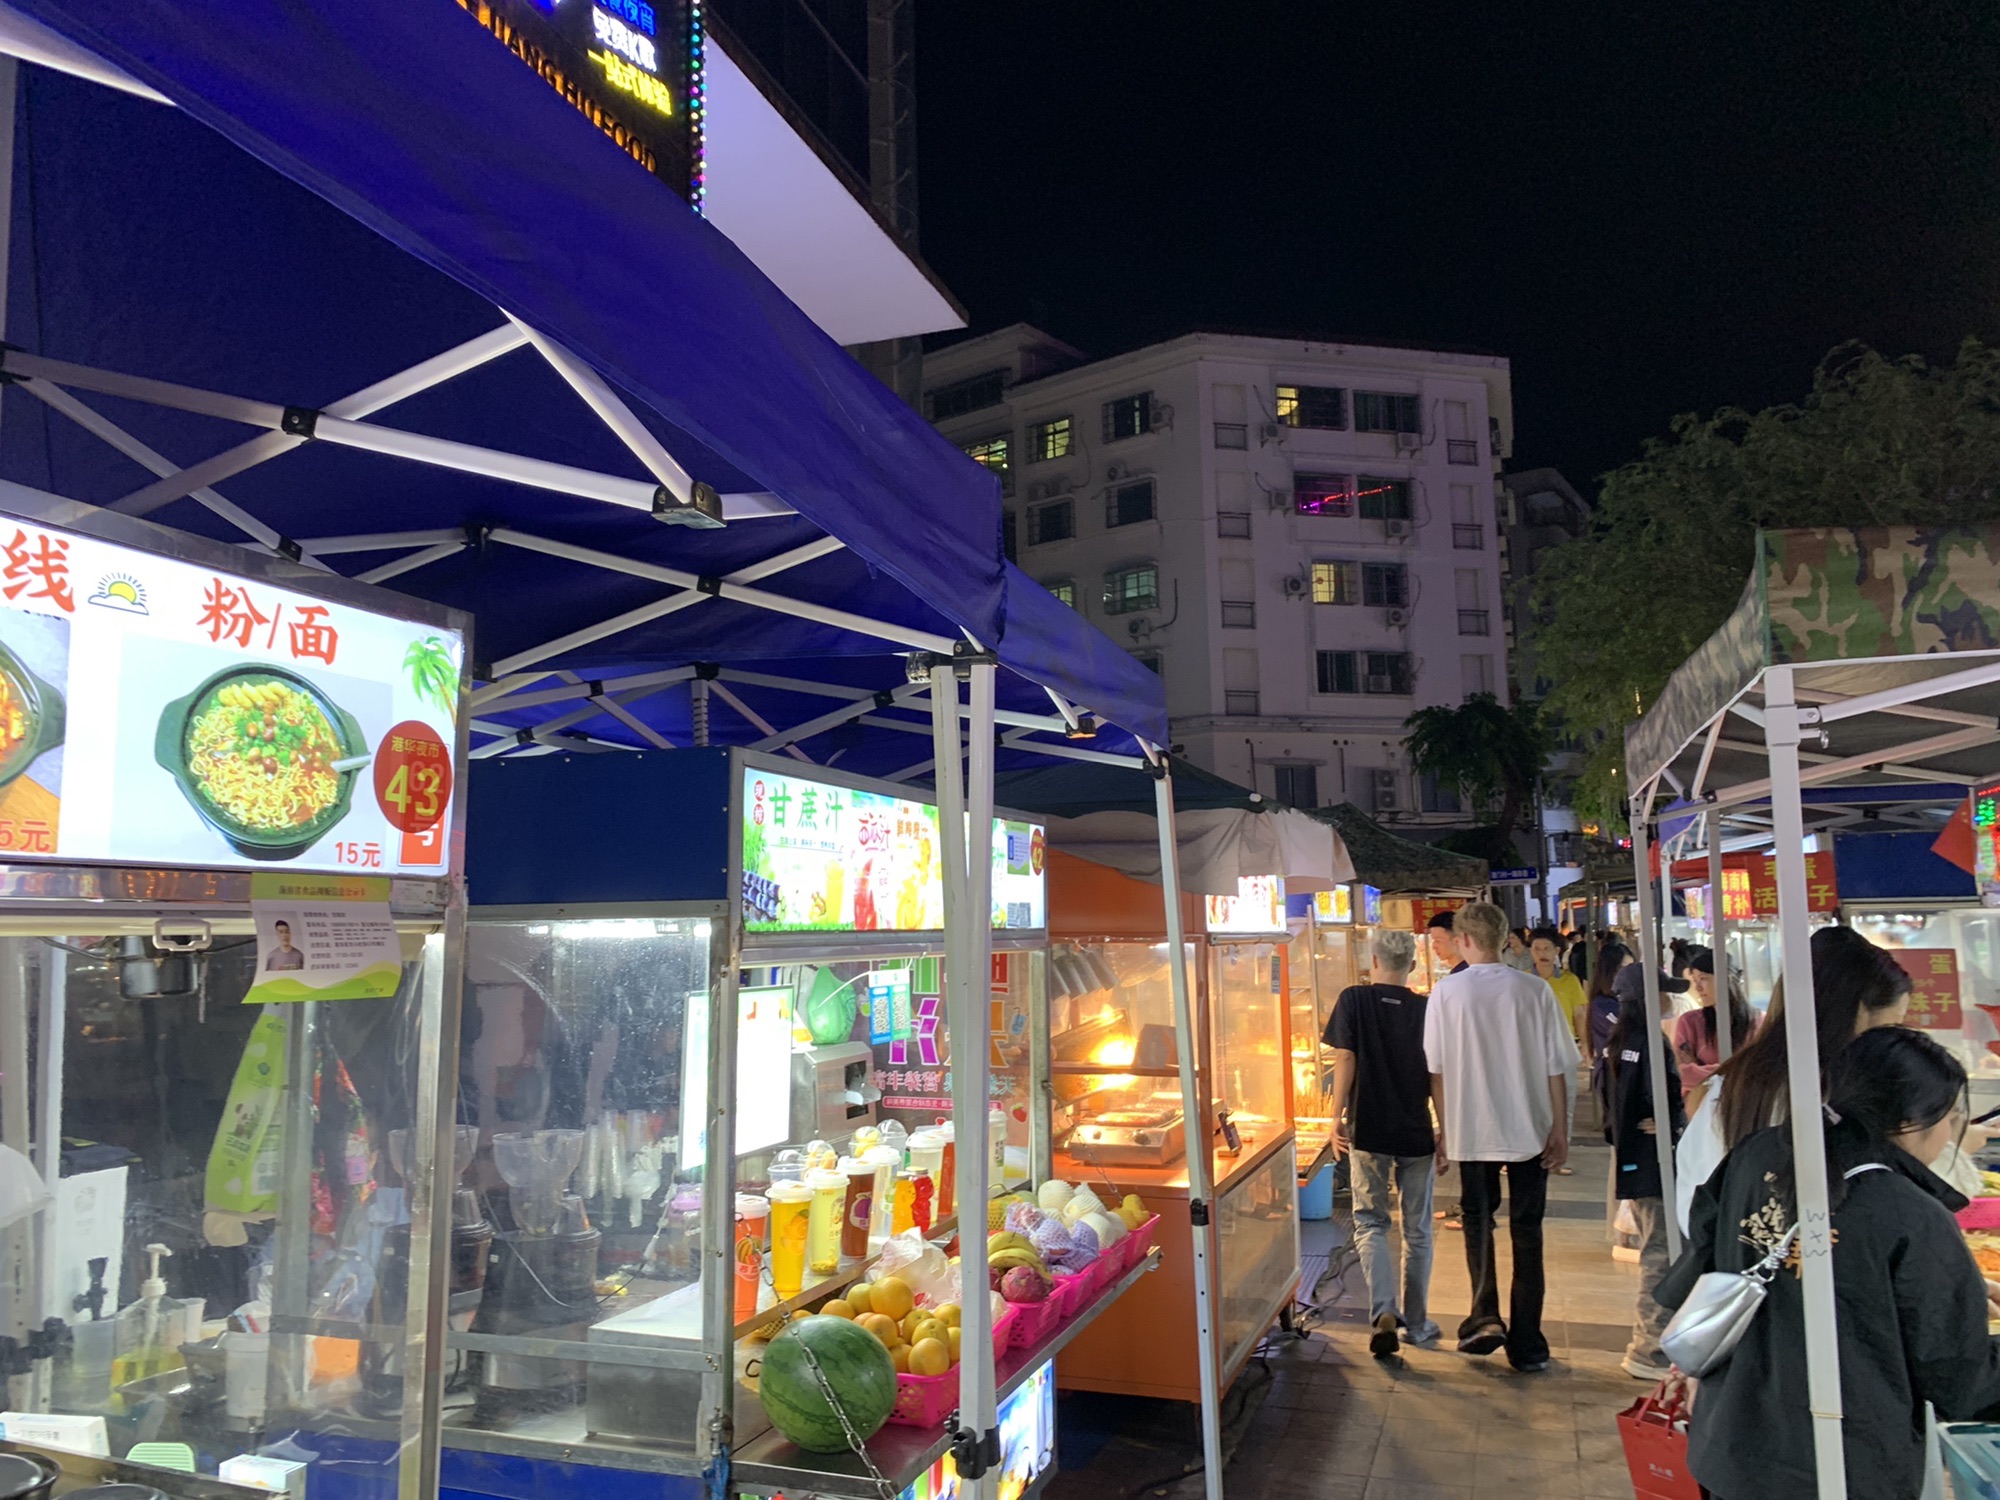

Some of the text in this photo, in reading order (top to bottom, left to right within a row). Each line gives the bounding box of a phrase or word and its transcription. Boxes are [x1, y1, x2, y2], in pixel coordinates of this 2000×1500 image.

[1, 528, 76, 613] 线
[196, 577, 339, 665] 粉/面
[391, 736, 440, 758] 港华夜市
[384, 764, 441, 817] 43
[768, 782, 844, 833] 甘蔗汁
[335, 841, 381, 868] 15元
[1032, 846, 1044, 870] 42
[1753, 885, 1835, 909] 活子
